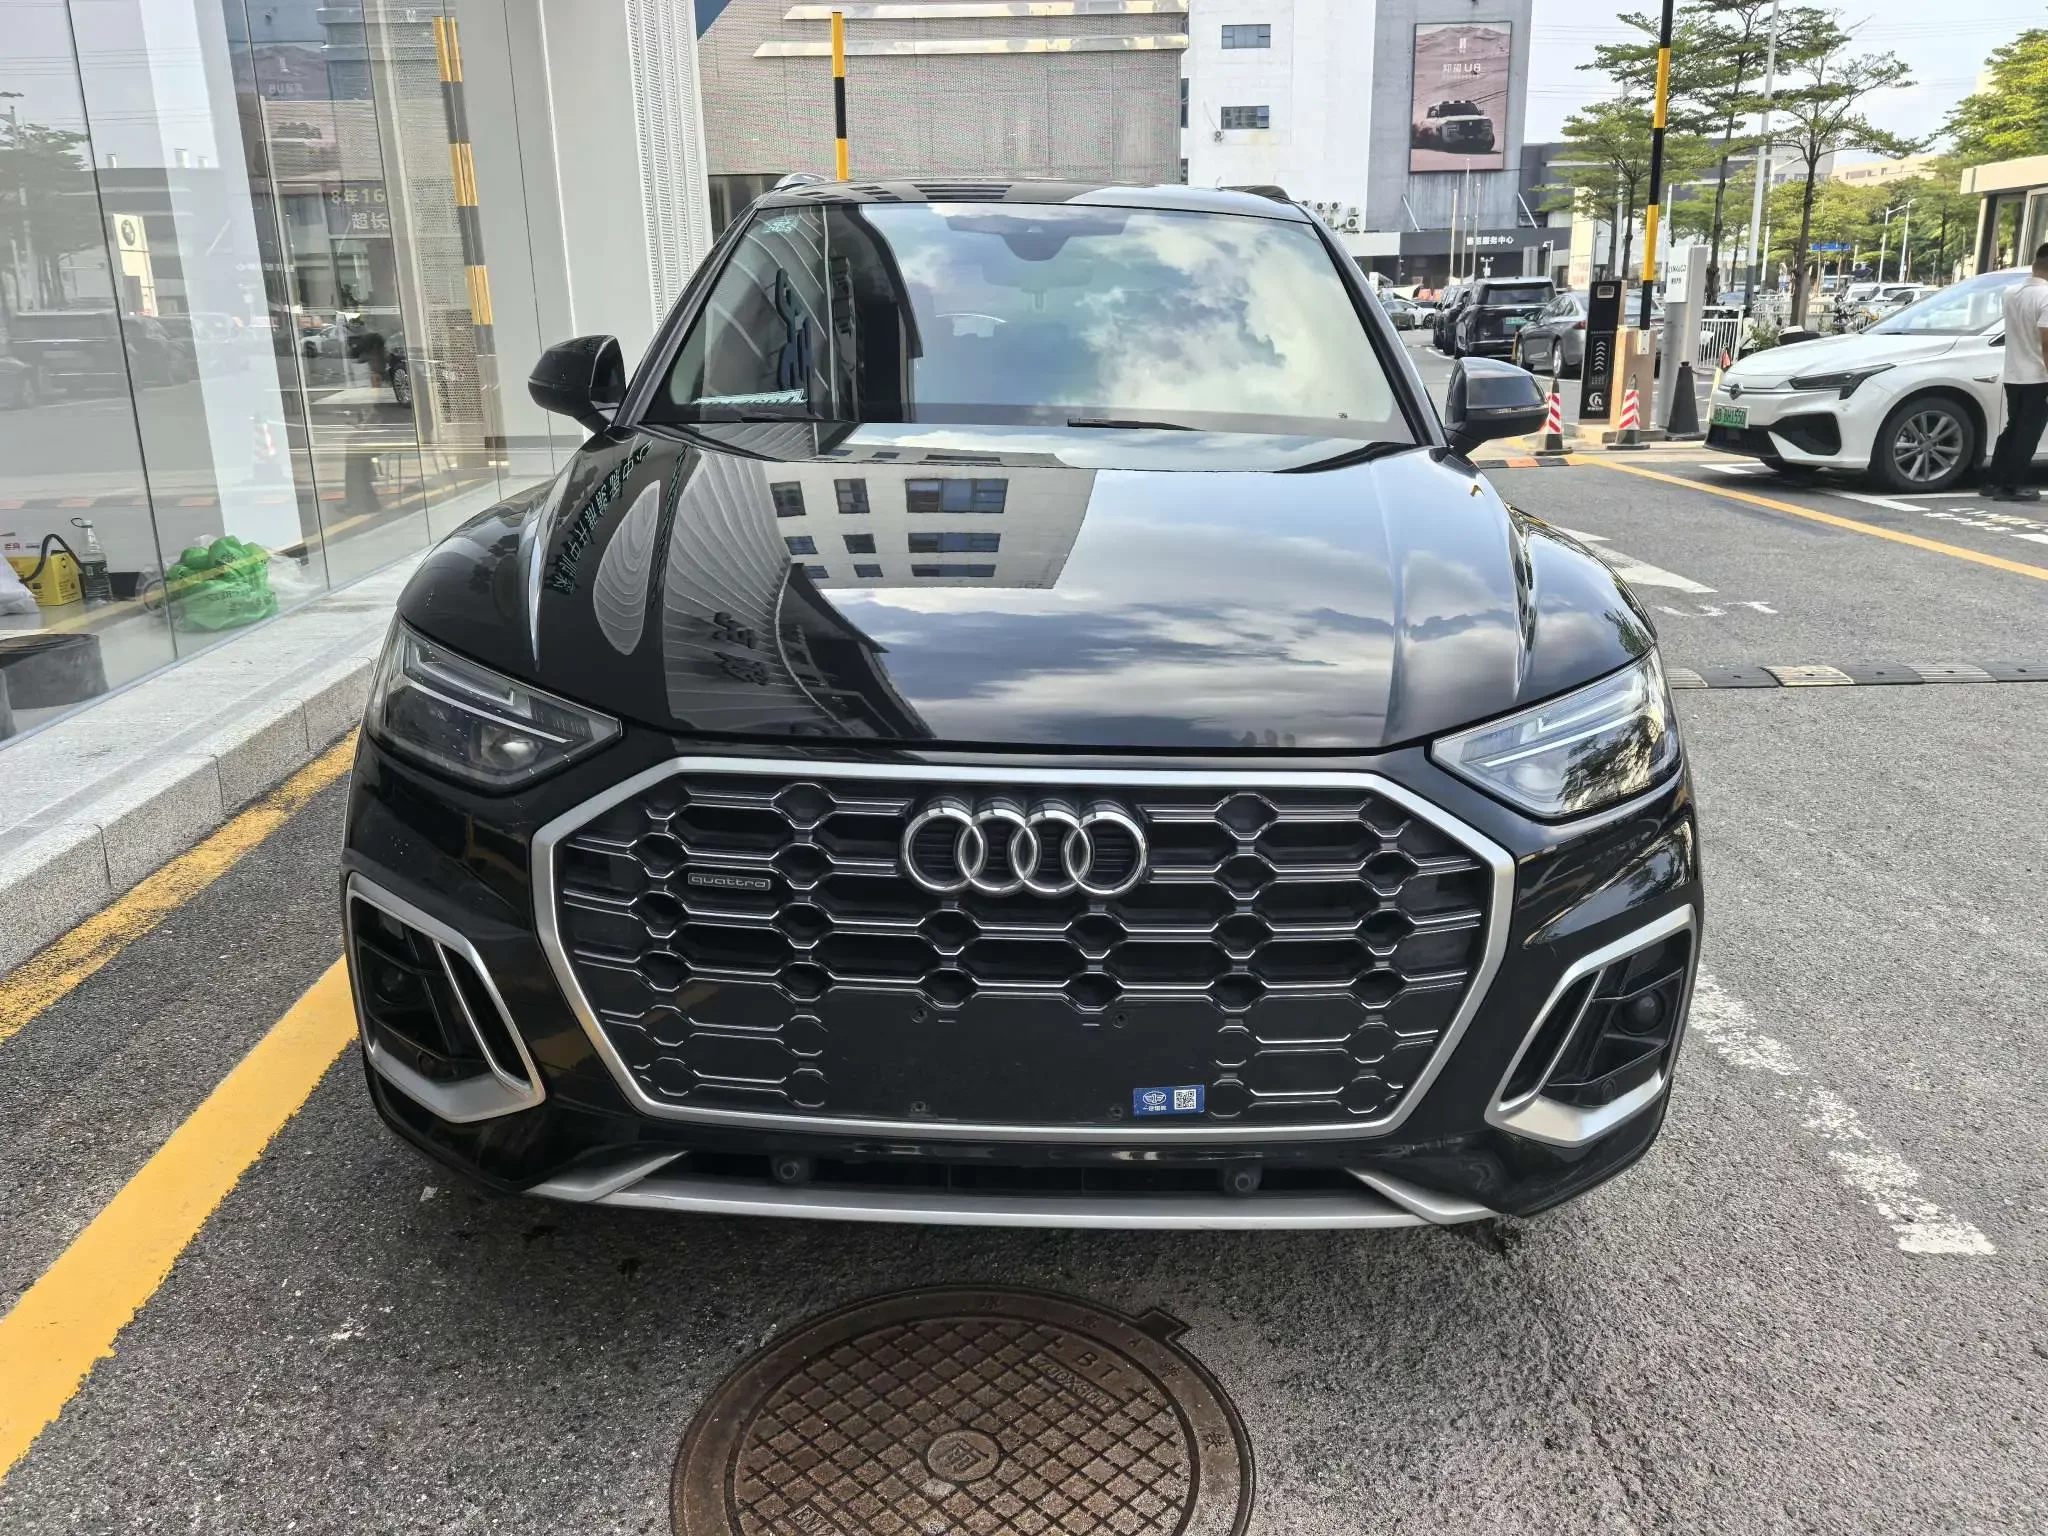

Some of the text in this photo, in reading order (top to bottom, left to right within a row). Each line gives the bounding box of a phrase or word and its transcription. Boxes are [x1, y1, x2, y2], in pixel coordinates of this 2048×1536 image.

[1464, 63, 1481, 72] U8
[352, 211, 389, 230] 超长
[691, 875, 766, 888] quattro
